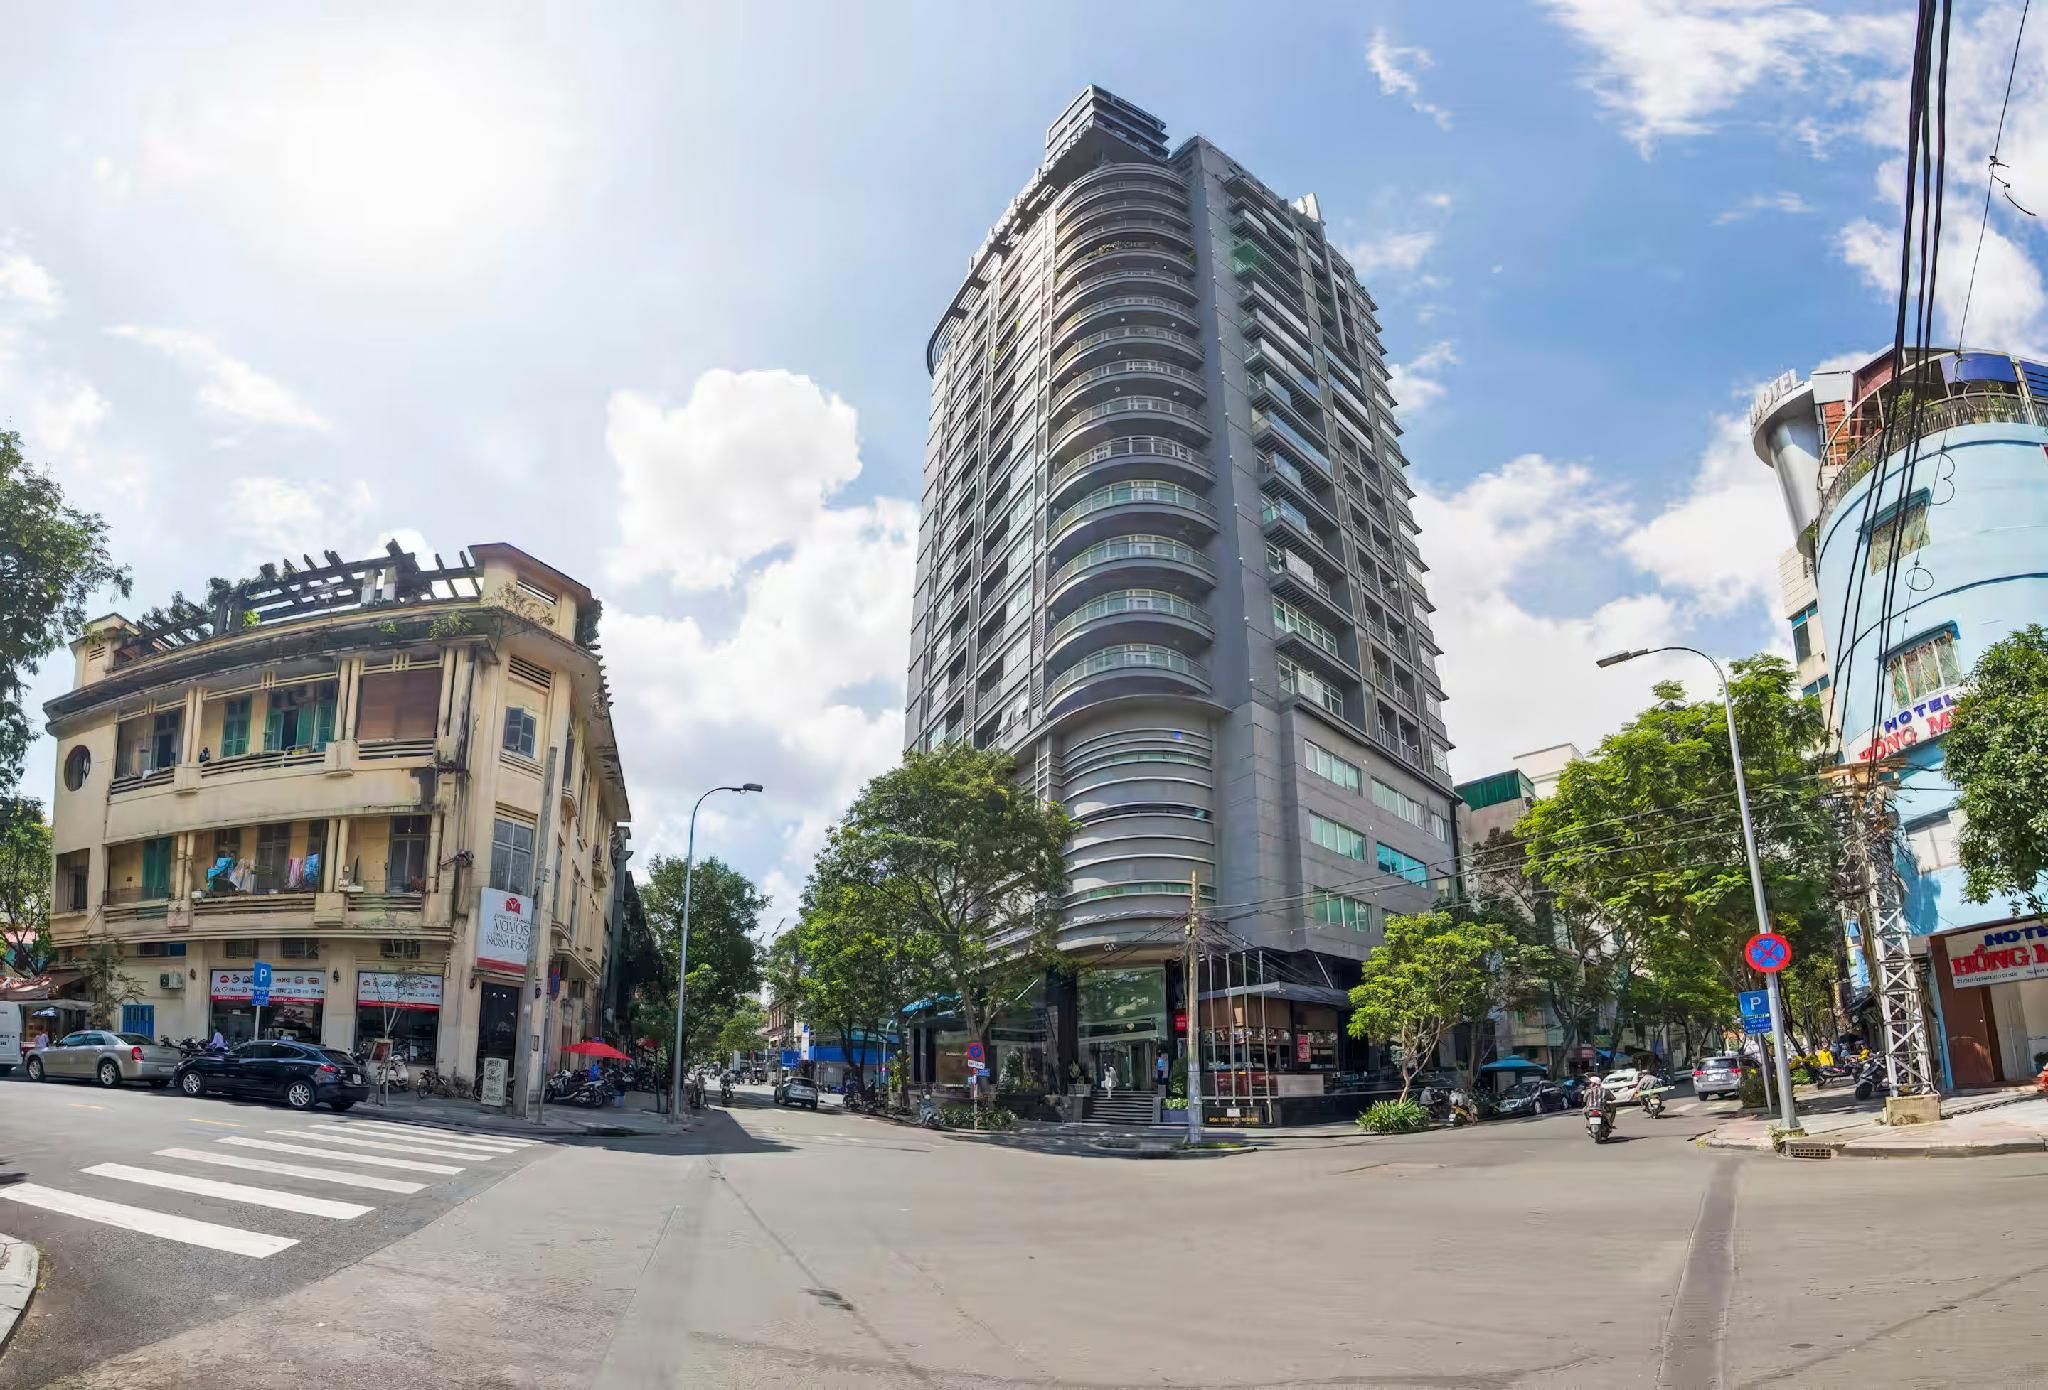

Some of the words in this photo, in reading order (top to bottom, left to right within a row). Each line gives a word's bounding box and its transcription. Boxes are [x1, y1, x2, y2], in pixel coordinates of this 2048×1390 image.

[1883, 694, 1953, 734] HOTEL
[260, 969, 267, 981] P
[1750, 997, 1761, 1010] P
